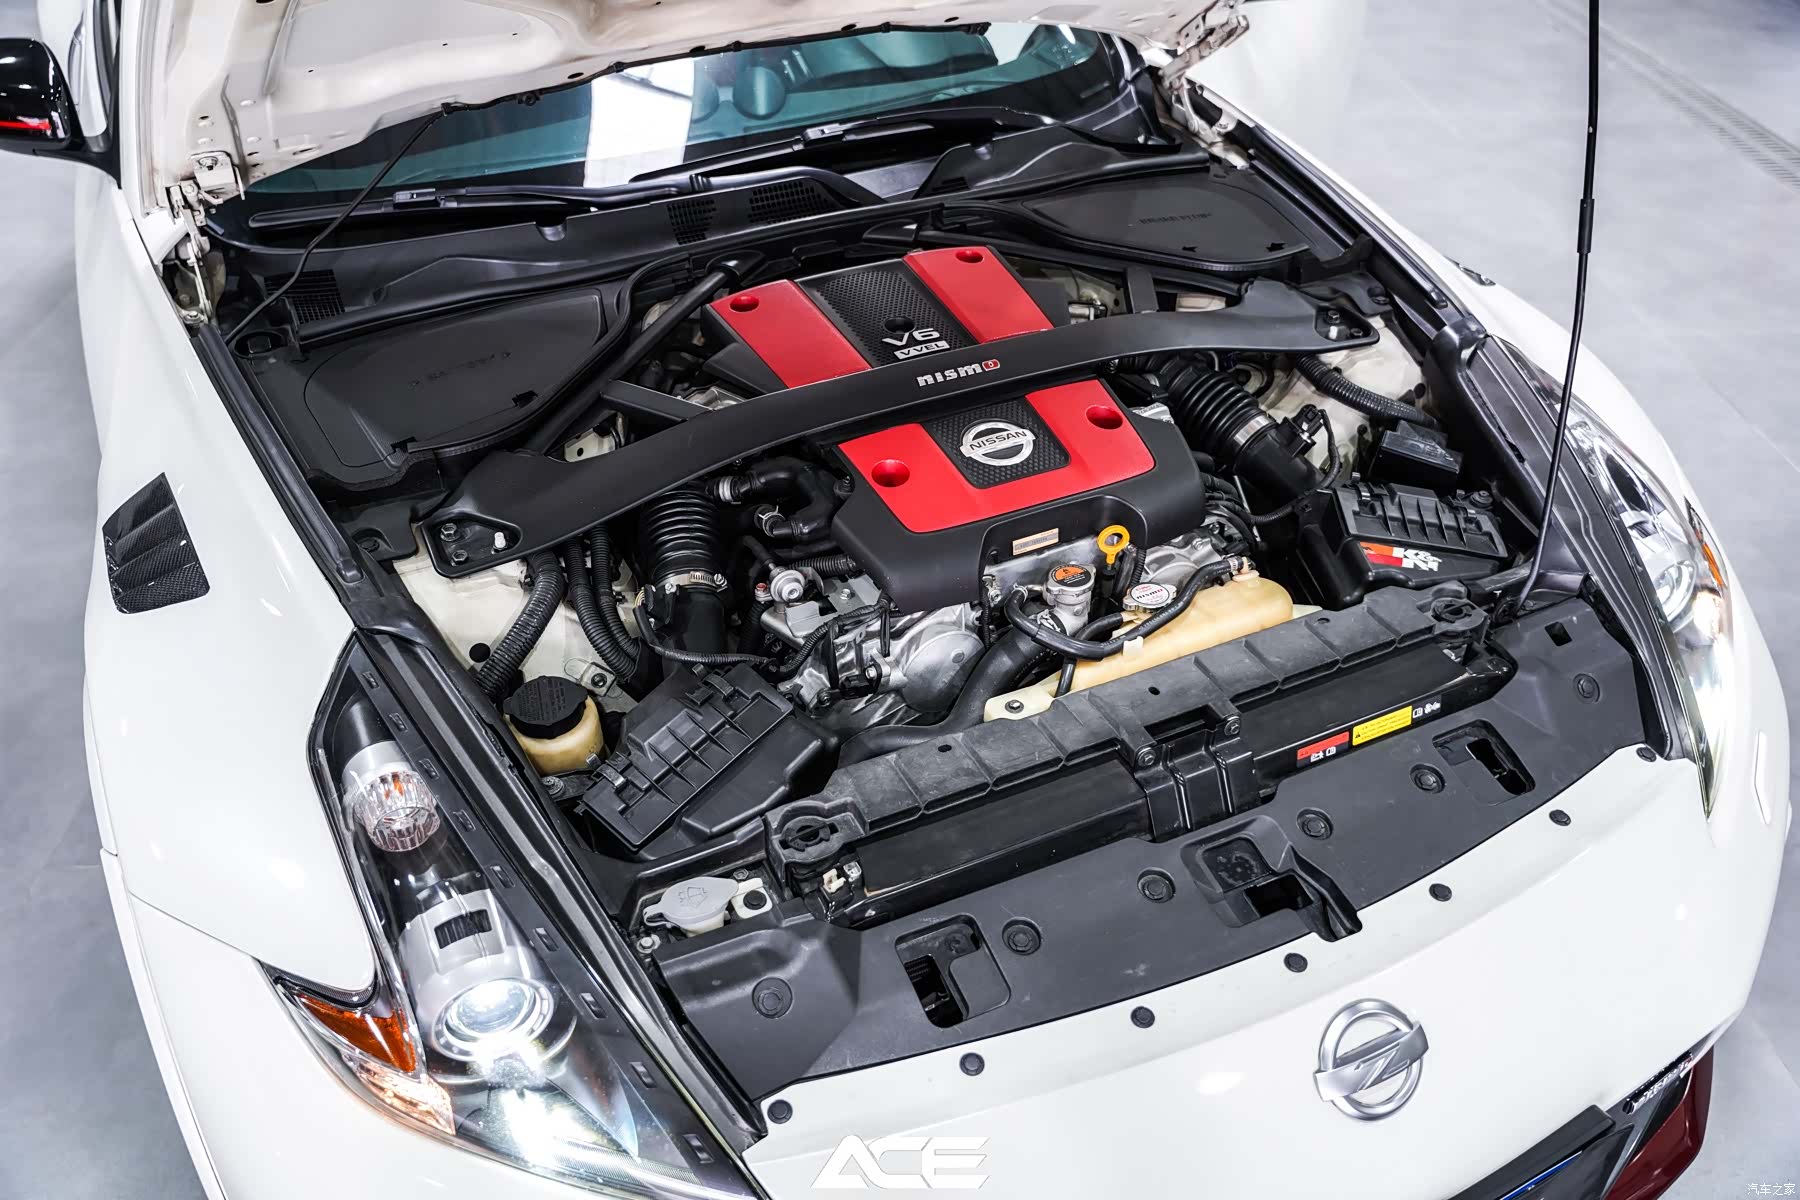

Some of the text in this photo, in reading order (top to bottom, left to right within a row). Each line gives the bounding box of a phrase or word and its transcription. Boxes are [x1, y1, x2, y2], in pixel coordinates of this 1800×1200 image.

[882, 328, 940, 346] V6
[899, 343, 945, 356] VVEL
[917, 358, 1000, 387] nismo
[969, 430, 1028, 451] NISSAN
[1392, 546, 1442, 572] K&N
